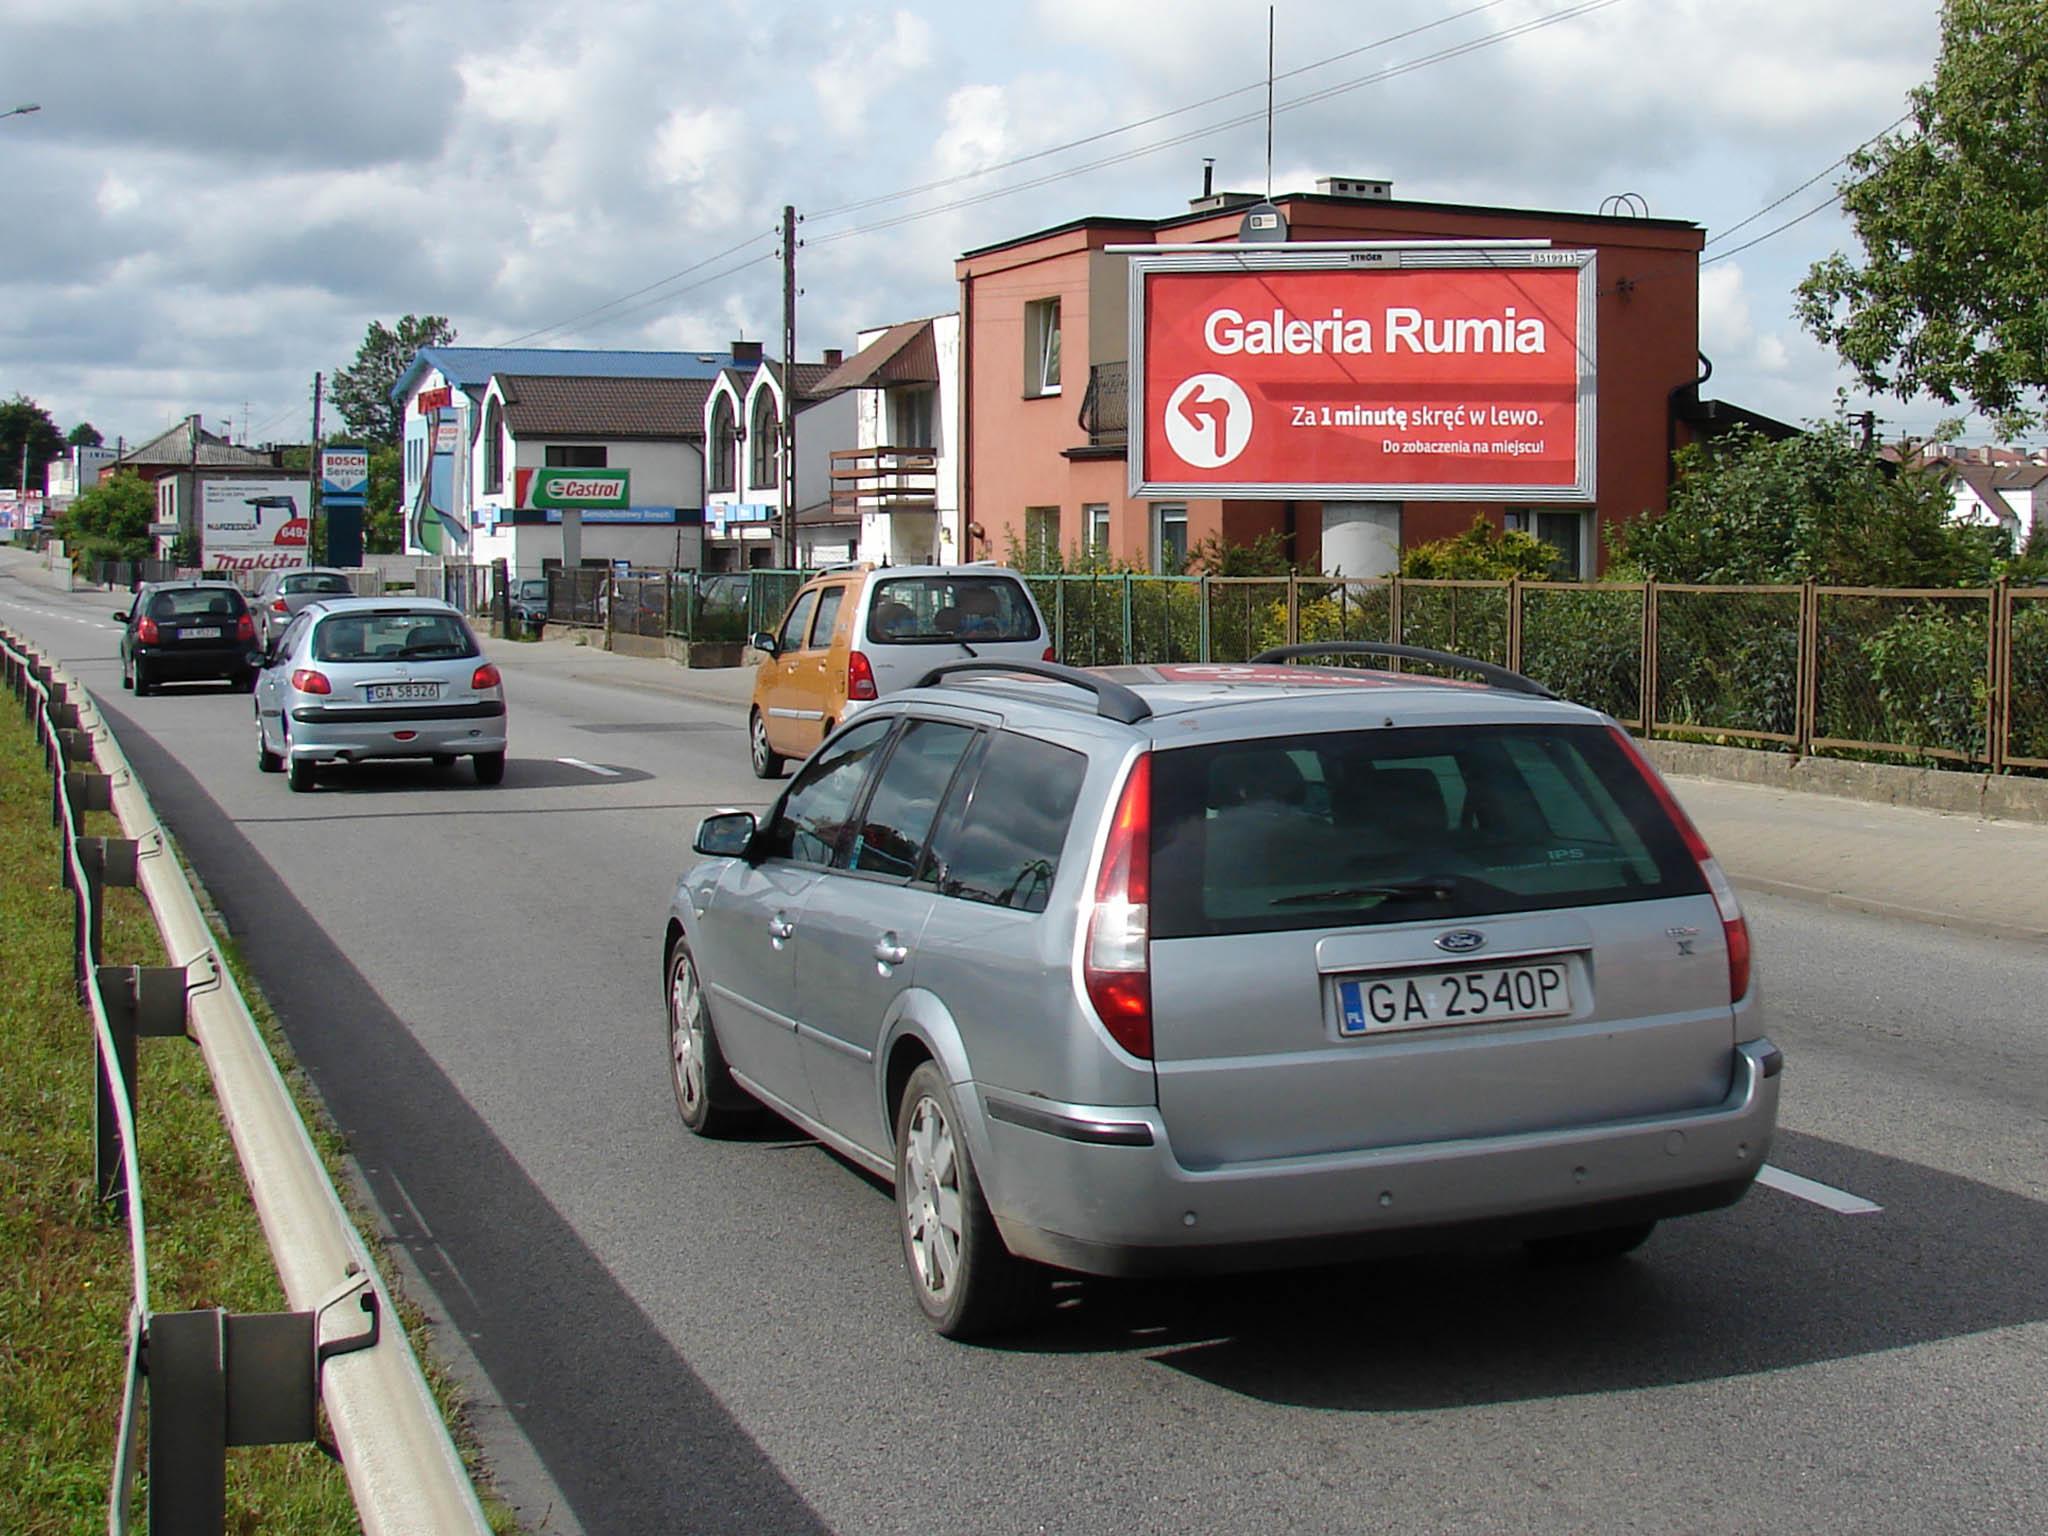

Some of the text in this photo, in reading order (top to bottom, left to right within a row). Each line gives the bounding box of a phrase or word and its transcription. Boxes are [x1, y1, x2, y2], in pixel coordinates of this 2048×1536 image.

[1204, 307, 1546, 355] Galeria Rumia
[1291, 405, 1545, 431] Za 1 minutę skręć w lewo.
[1383, 440, 1545, 456] Do zobaczenia na miejscu!
[326, 456, 366, 466] BOSCH
[325, 466, 366, 476] Service
[566, 481, 619, 497] Castrol
[375, 687, 393, 699] GA
[1348, 967, 1560, 1025] PL GA 2540P
